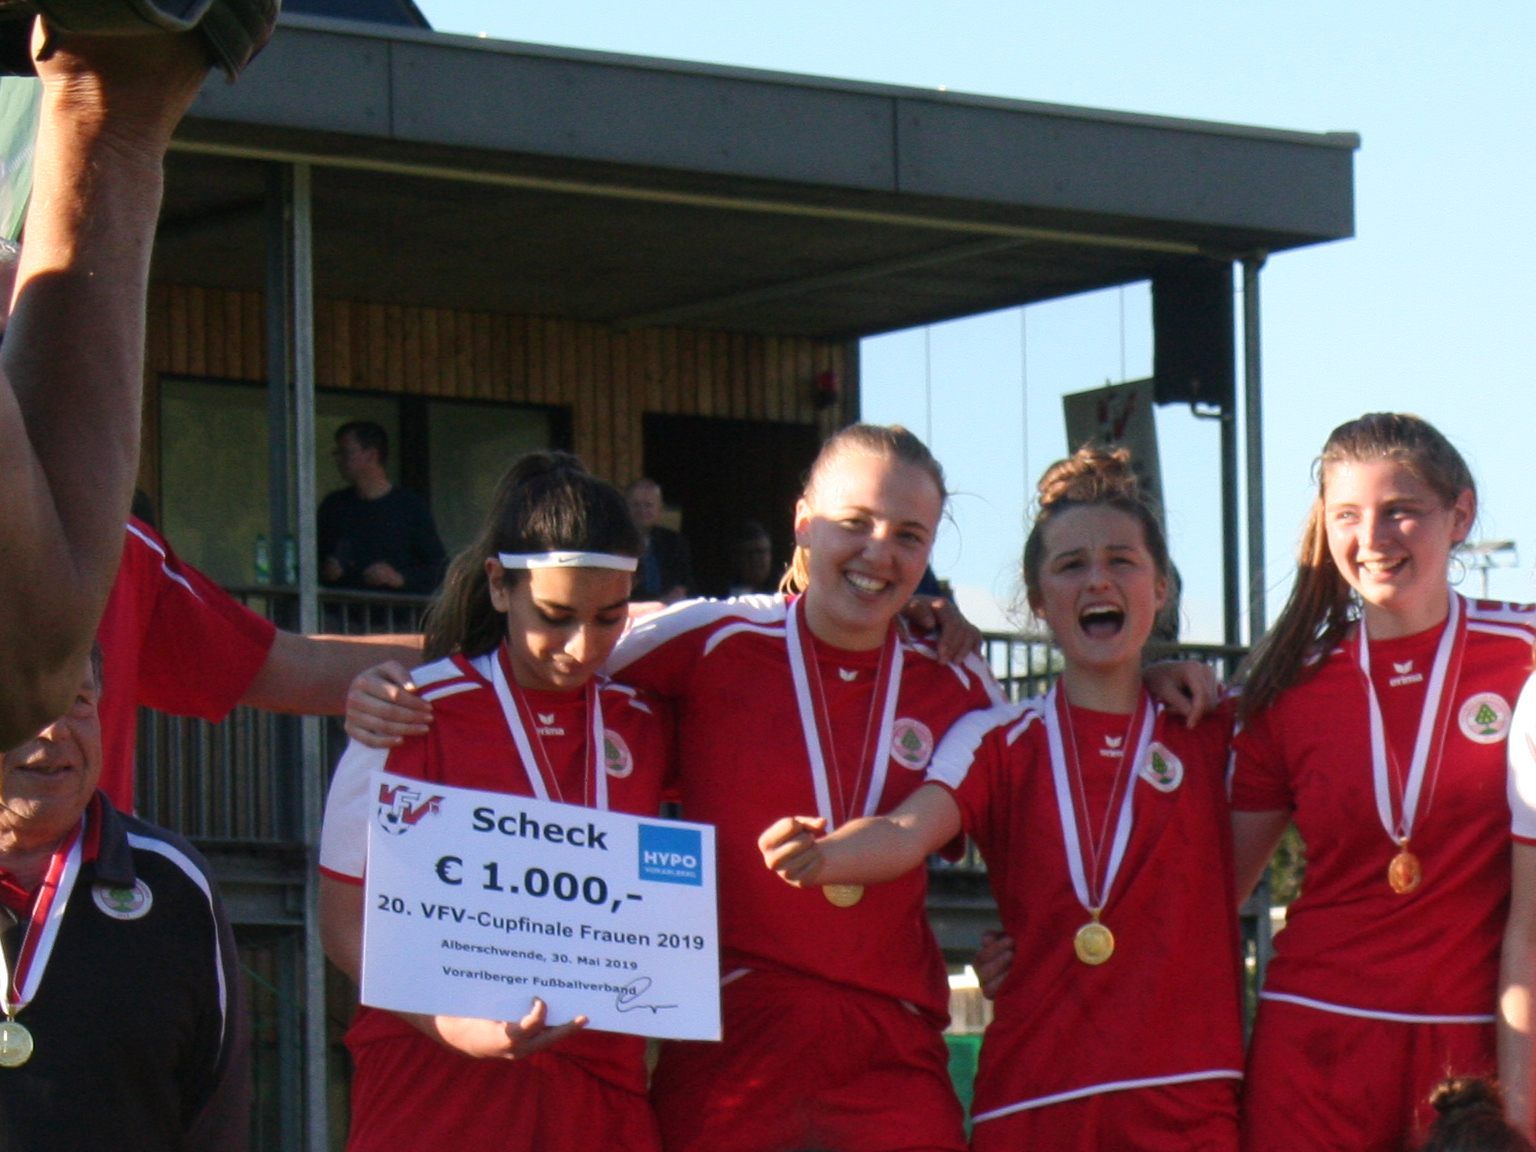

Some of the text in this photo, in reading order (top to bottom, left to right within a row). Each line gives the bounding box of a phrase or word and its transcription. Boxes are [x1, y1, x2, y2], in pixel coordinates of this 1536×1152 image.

[471, 806, 608, 851] Scheck
[643, 850, 697, 869] HYPO
[434, 855, 643, 914] € 1.000,-
[377, 894, 705, 951] 20. VFV-Cupfinale Frauen 2019
[441, 939, 638, 971] Alberschwende, 30. Mai 2019
[442, 965, 529, 985] Vorarlberger
[532, 976, 637, 996] Fußballverband
